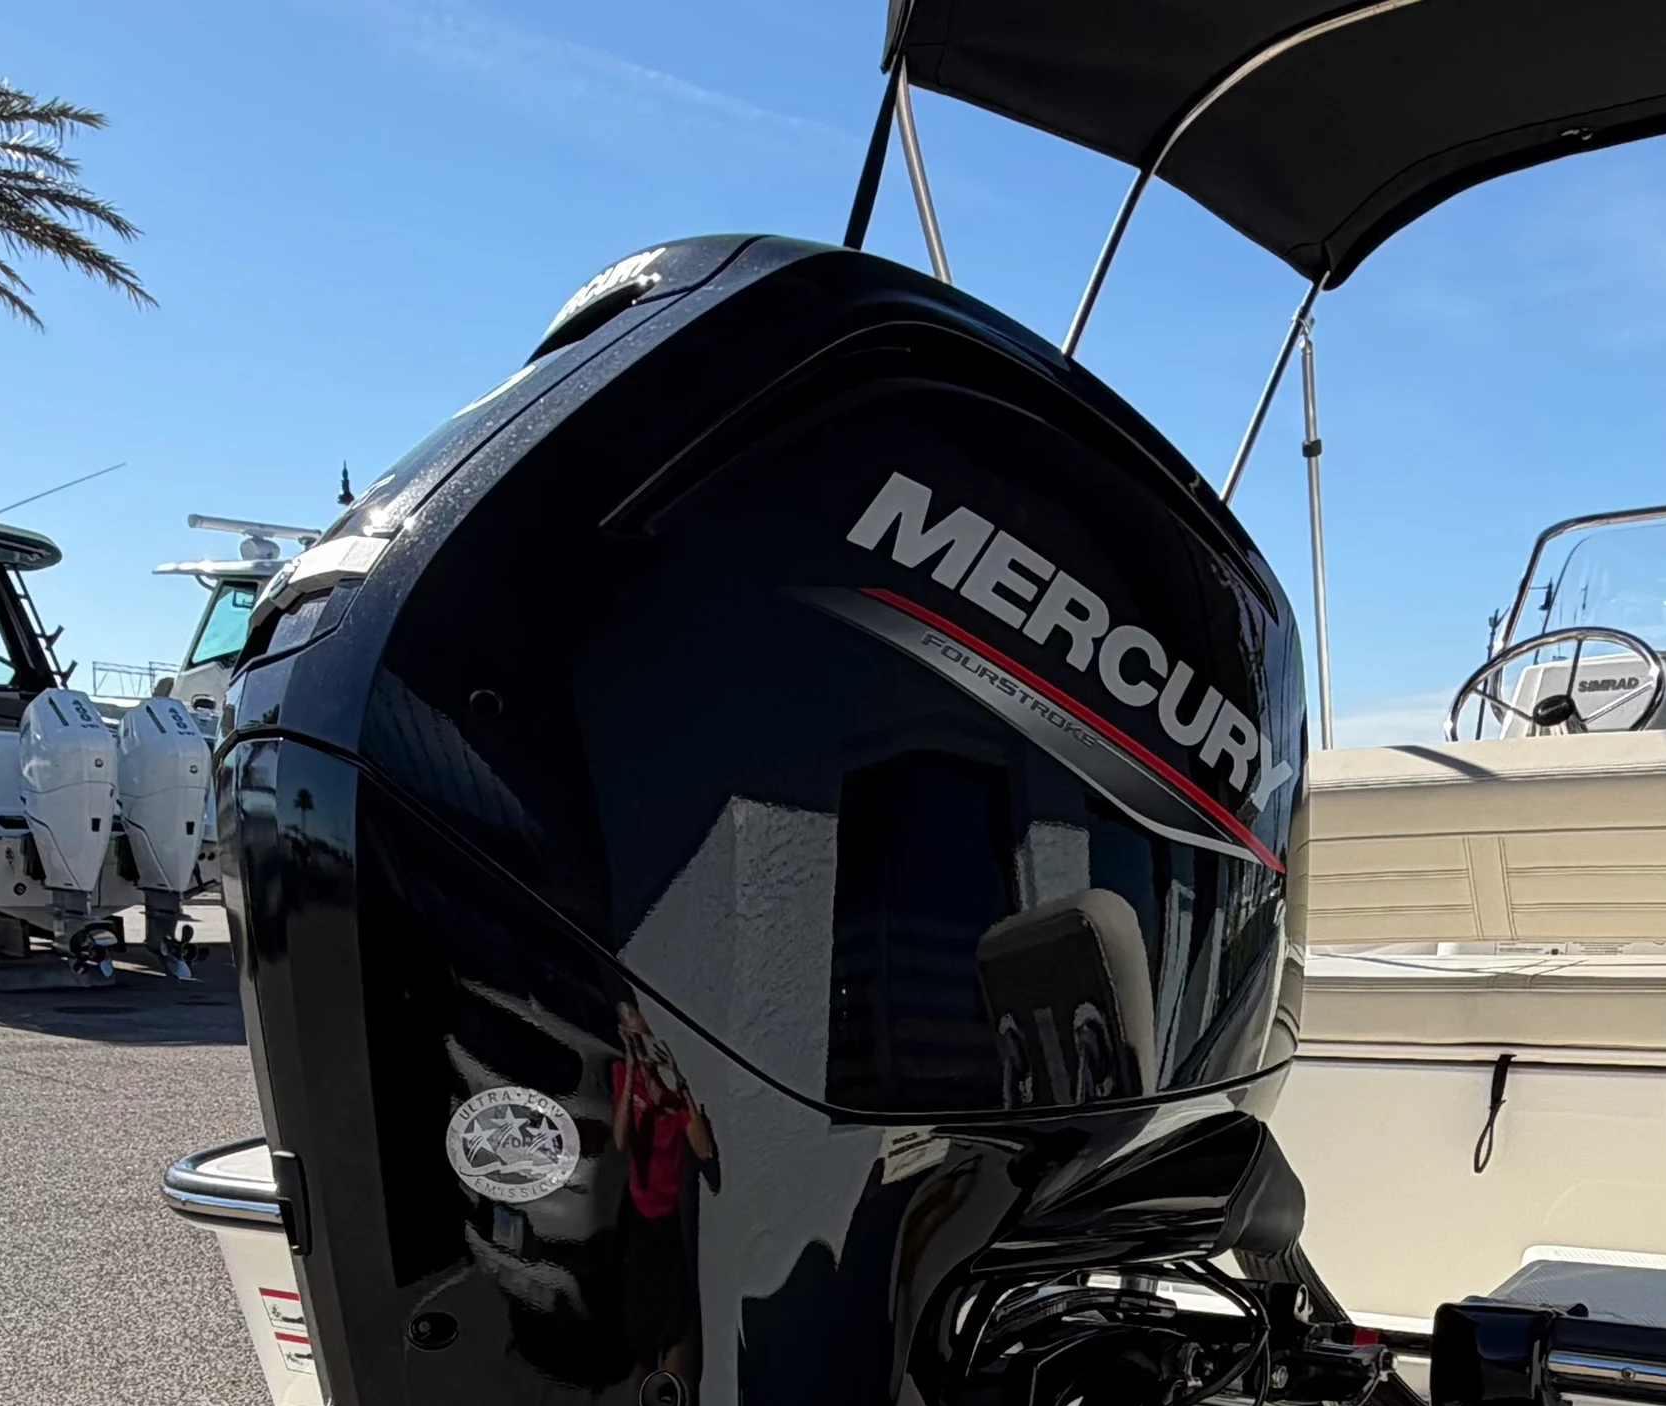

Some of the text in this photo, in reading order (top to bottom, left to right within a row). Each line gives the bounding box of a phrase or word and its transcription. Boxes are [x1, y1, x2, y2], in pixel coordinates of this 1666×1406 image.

[846, 471, 1293, 812] MERCURY
[921, 631, 1101, 748] FOURSTROKE
[1578, 677, 1640, 694] SIMRAD
[459, 1091, 512, 1120] ULTRA
[527, 1093, 564, 1119] LOW
